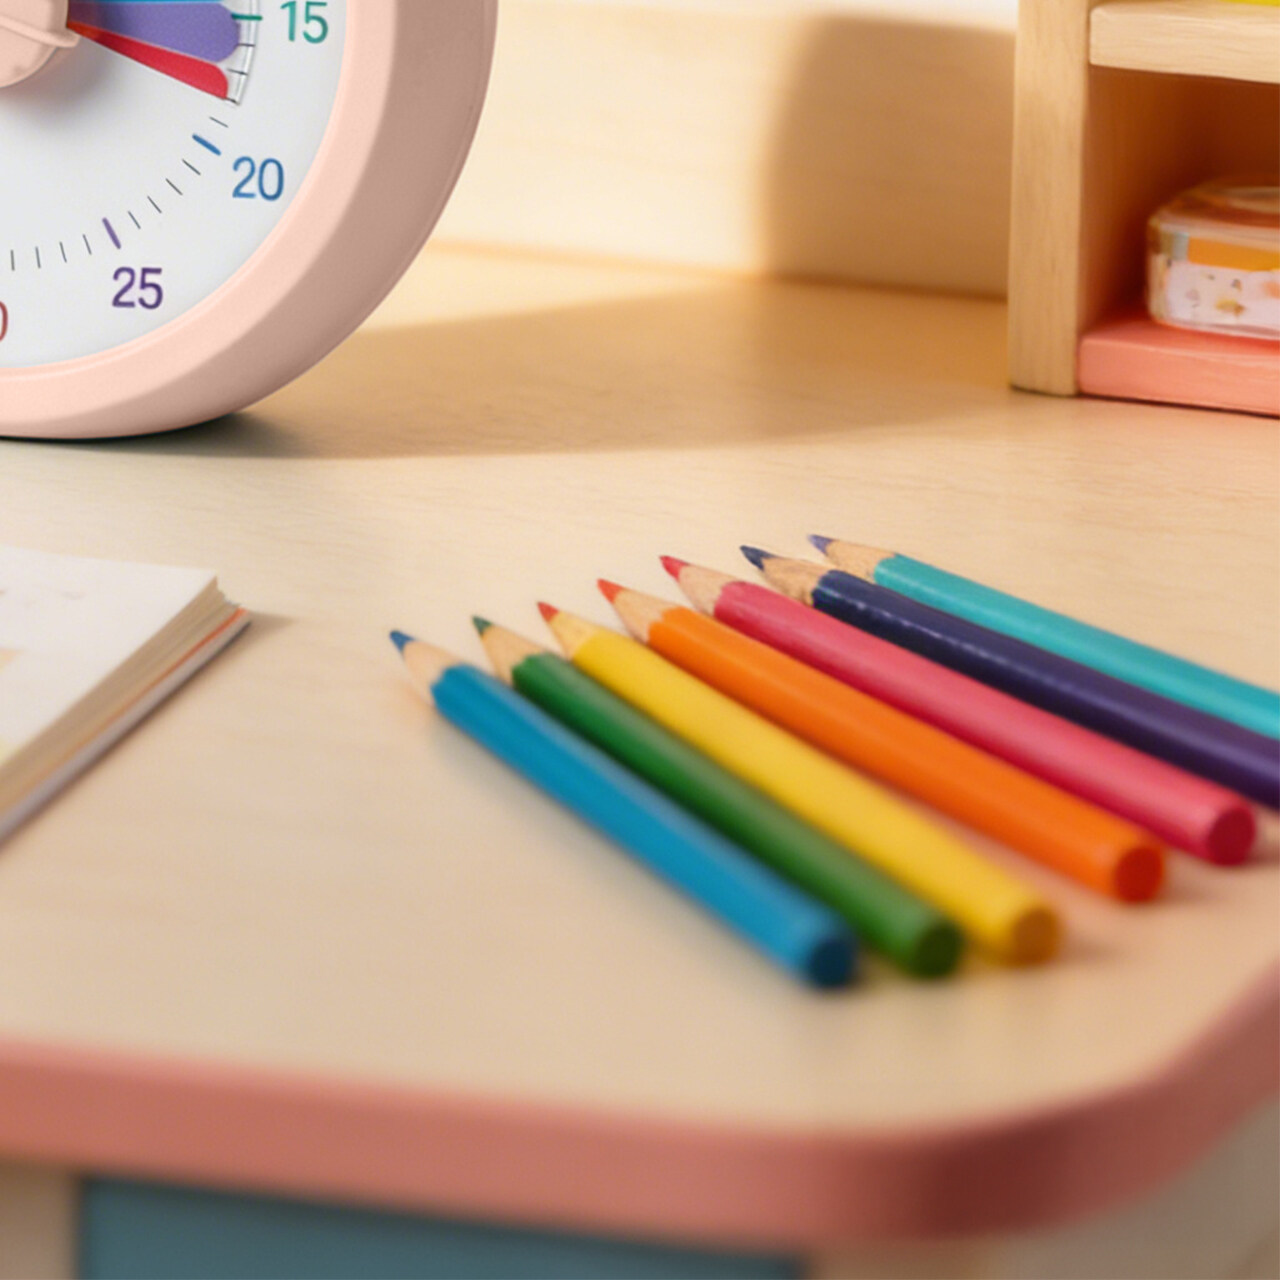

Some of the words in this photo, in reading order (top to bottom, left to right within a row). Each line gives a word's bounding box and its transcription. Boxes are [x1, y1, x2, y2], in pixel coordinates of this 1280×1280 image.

[280, 1, 328, 44] 15
[232, 157, 284, 201] 20
[112, 267, 163, 309] 25
